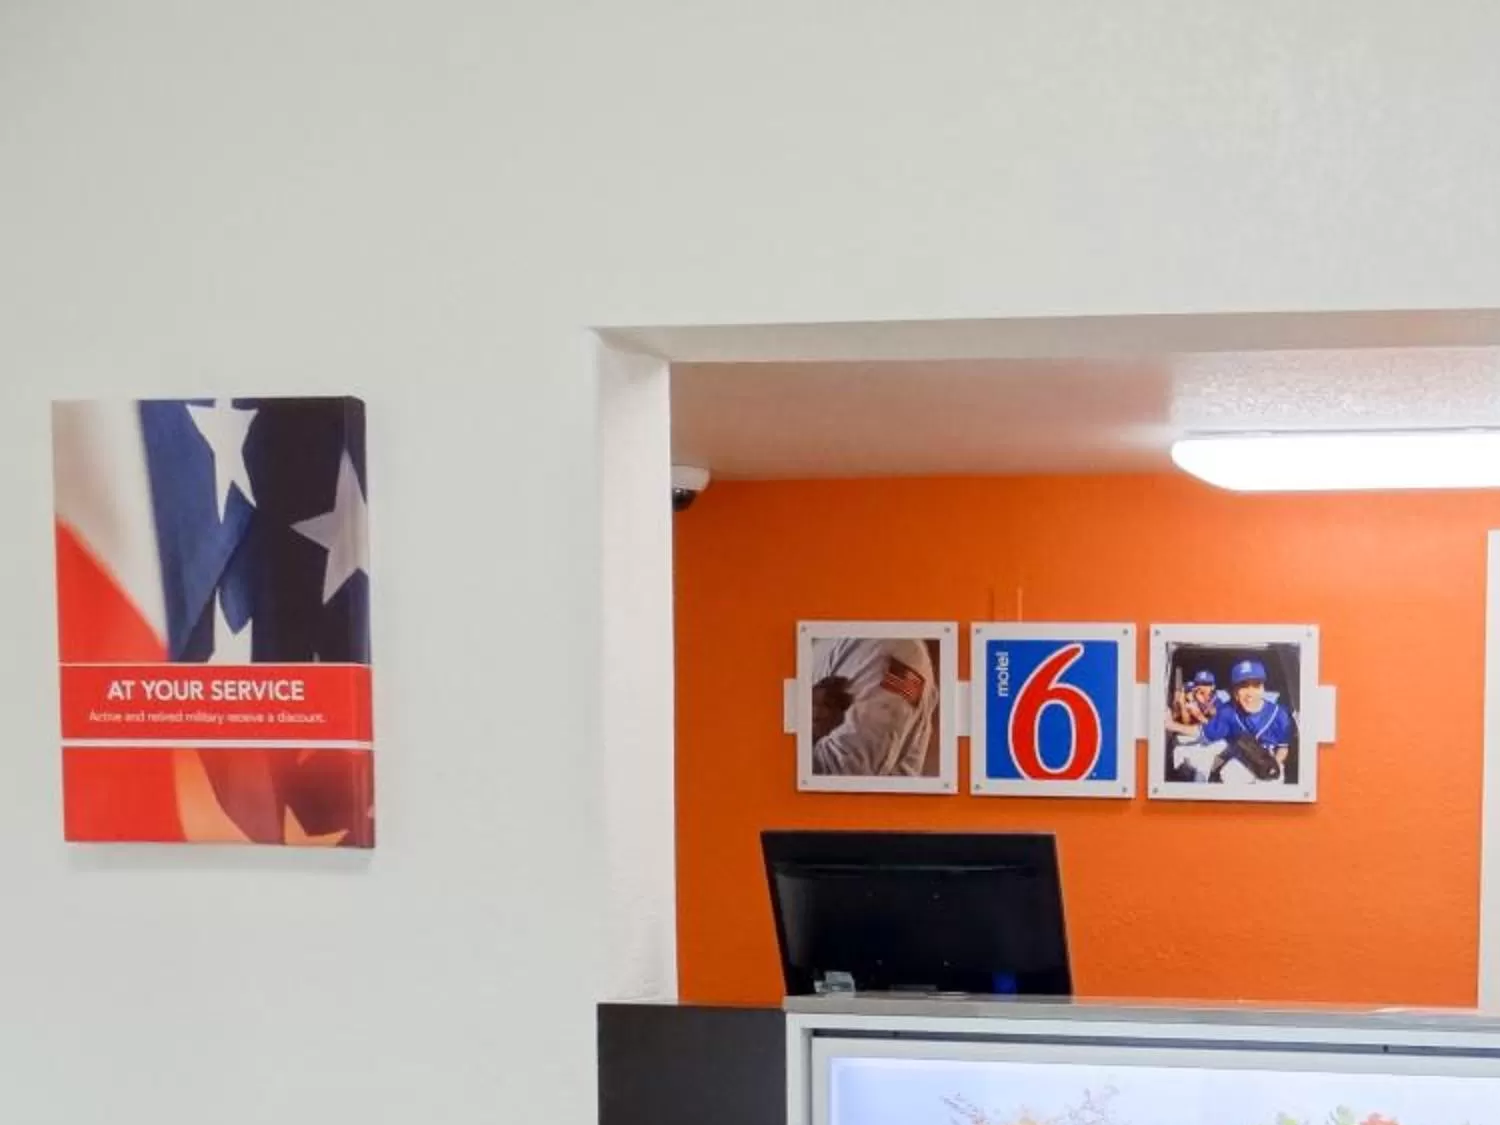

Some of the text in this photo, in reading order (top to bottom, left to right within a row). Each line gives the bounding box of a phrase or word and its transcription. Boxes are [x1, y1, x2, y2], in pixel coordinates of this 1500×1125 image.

[107, 679, 305, 701] AT YOUR SERVICE
[89, 709, 122, 722] Active
[125, 710, 145, 722] and
[185, 710, 224, 725] military
[994, 643, 1102, 783] motel 6
